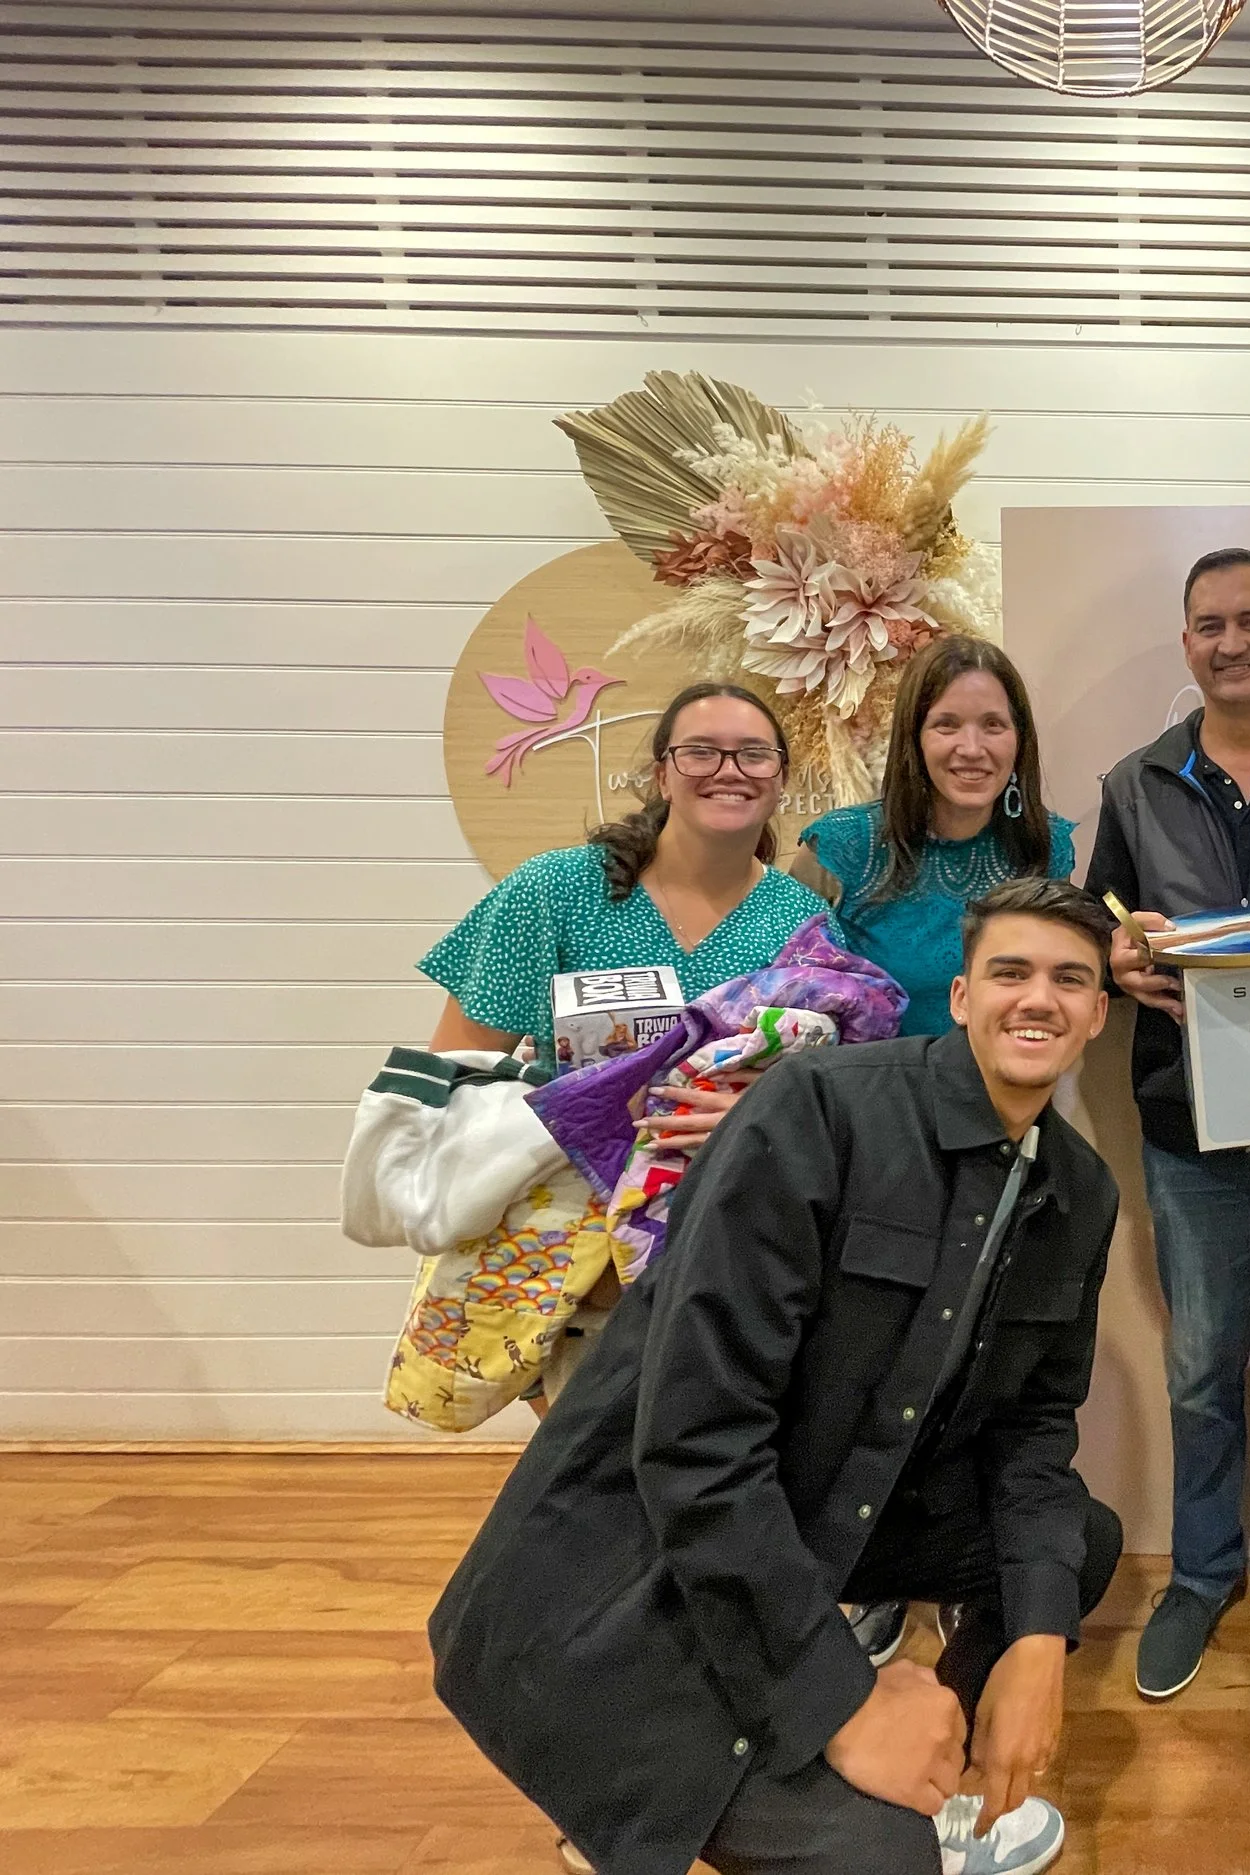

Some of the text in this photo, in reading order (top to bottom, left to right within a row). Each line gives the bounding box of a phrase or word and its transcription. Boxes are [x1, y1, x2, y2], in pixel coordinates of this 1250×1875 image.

[779, 793, 836, 815] PECT
[580, 974, 627, 1005] BOX
[623, 971, 661, 1001] TRIVIA
[636, 1016, 679, 1033] TRIVIA
[637, 1031, 665, 1050] BO
